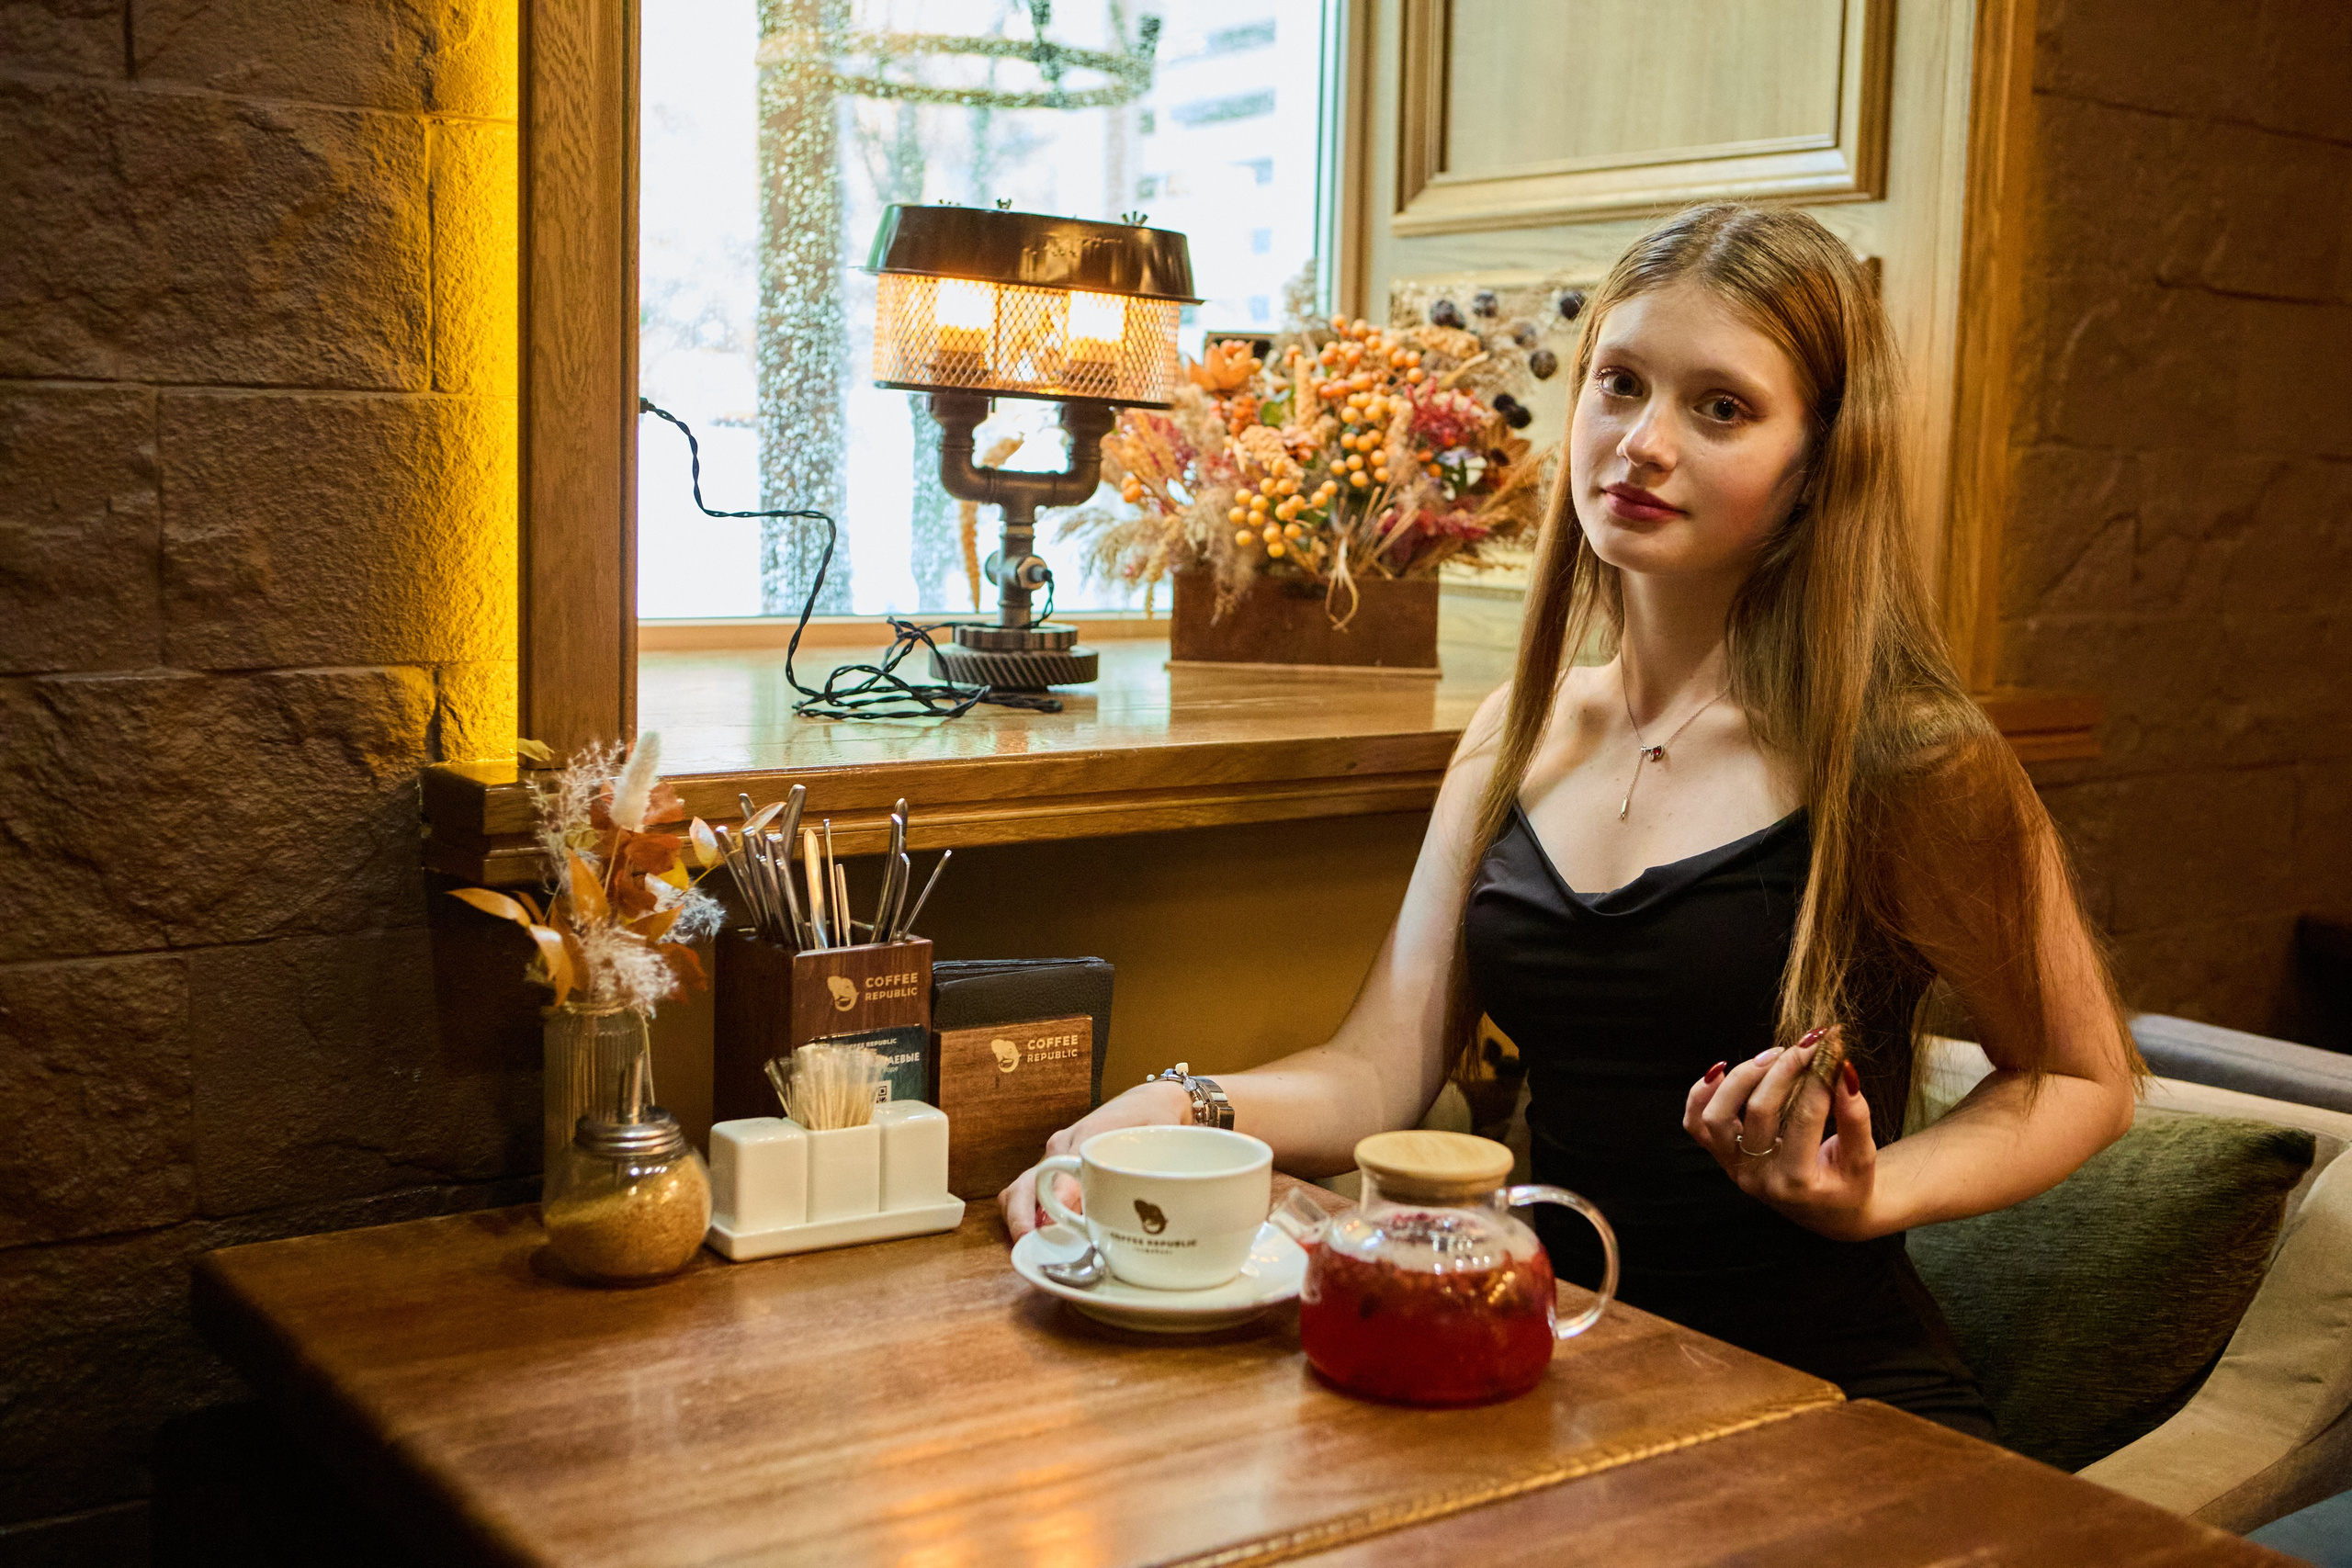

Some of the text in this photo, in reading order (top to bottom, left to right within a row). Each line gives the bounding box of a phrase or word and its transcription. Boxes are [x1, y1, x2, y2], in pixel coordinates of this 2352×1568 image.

[865, 973, 918, 988] COFFEE
[865, 987, 918, 1001] REPUBLIC
[865, 1038, 898, 1047] REPUBLIC
[1027, 1035, 1079, 1050] COFFEE
[1027, 1049, 1078, 1063] REPUBLIC
[1110, 1232, 1196, 1247] COFFEE REPUBLIC
